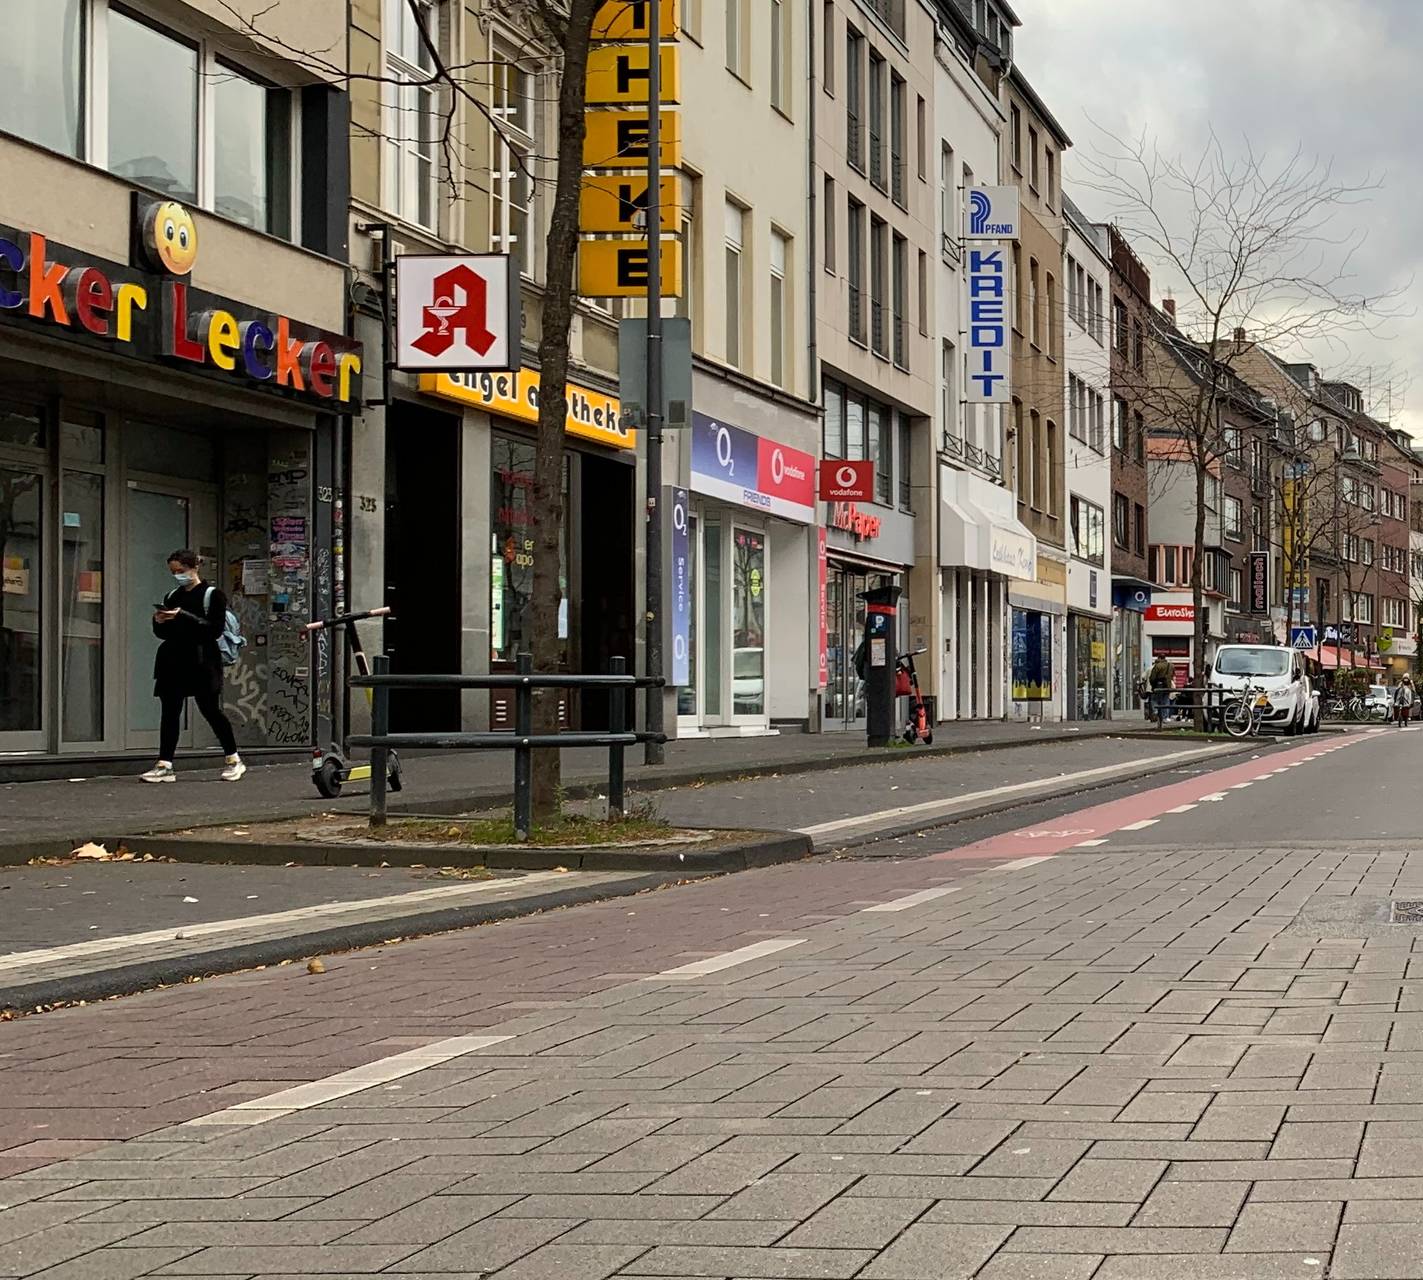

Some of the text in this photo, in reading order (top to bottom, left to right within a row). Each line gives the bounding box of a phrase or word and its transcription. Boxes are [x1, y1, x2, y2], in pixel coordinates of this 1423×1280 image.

[985, 224, 1013, 234] PFAND
[970, 250, 1004, 397] KREDIT
[171, 281, 361, 402] Lecker
[528, 385, 627, 435] athek
[829, 488, 863, 497] vodafone
[1156, 607, 1195, 618] EuroSho
